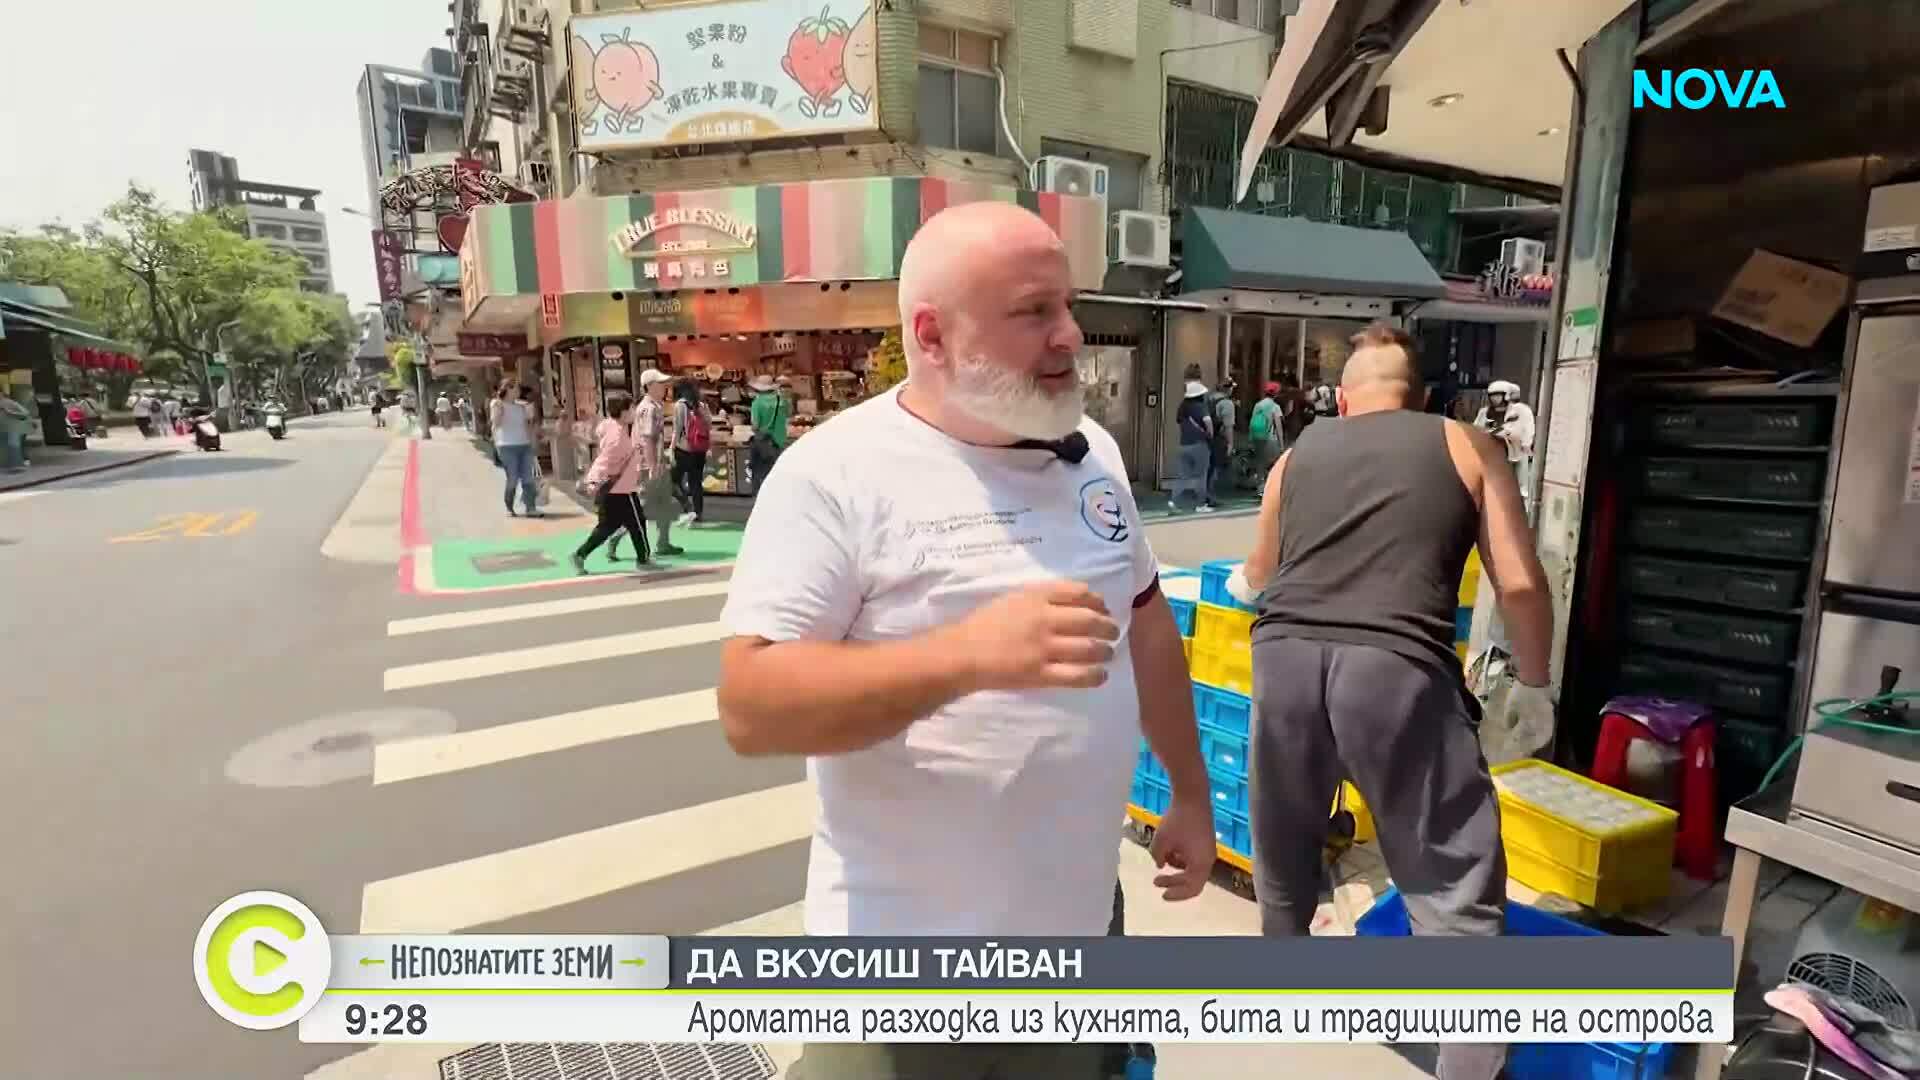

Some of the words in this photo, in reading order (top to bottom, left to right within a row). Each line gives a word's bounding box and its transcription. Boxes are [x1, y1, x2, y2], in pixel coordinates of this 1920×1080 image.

[686, 23, 747, 51] 堅果粉
[712, 54, 724, 69] &
[666, 207, 757, 250] BLESSING
